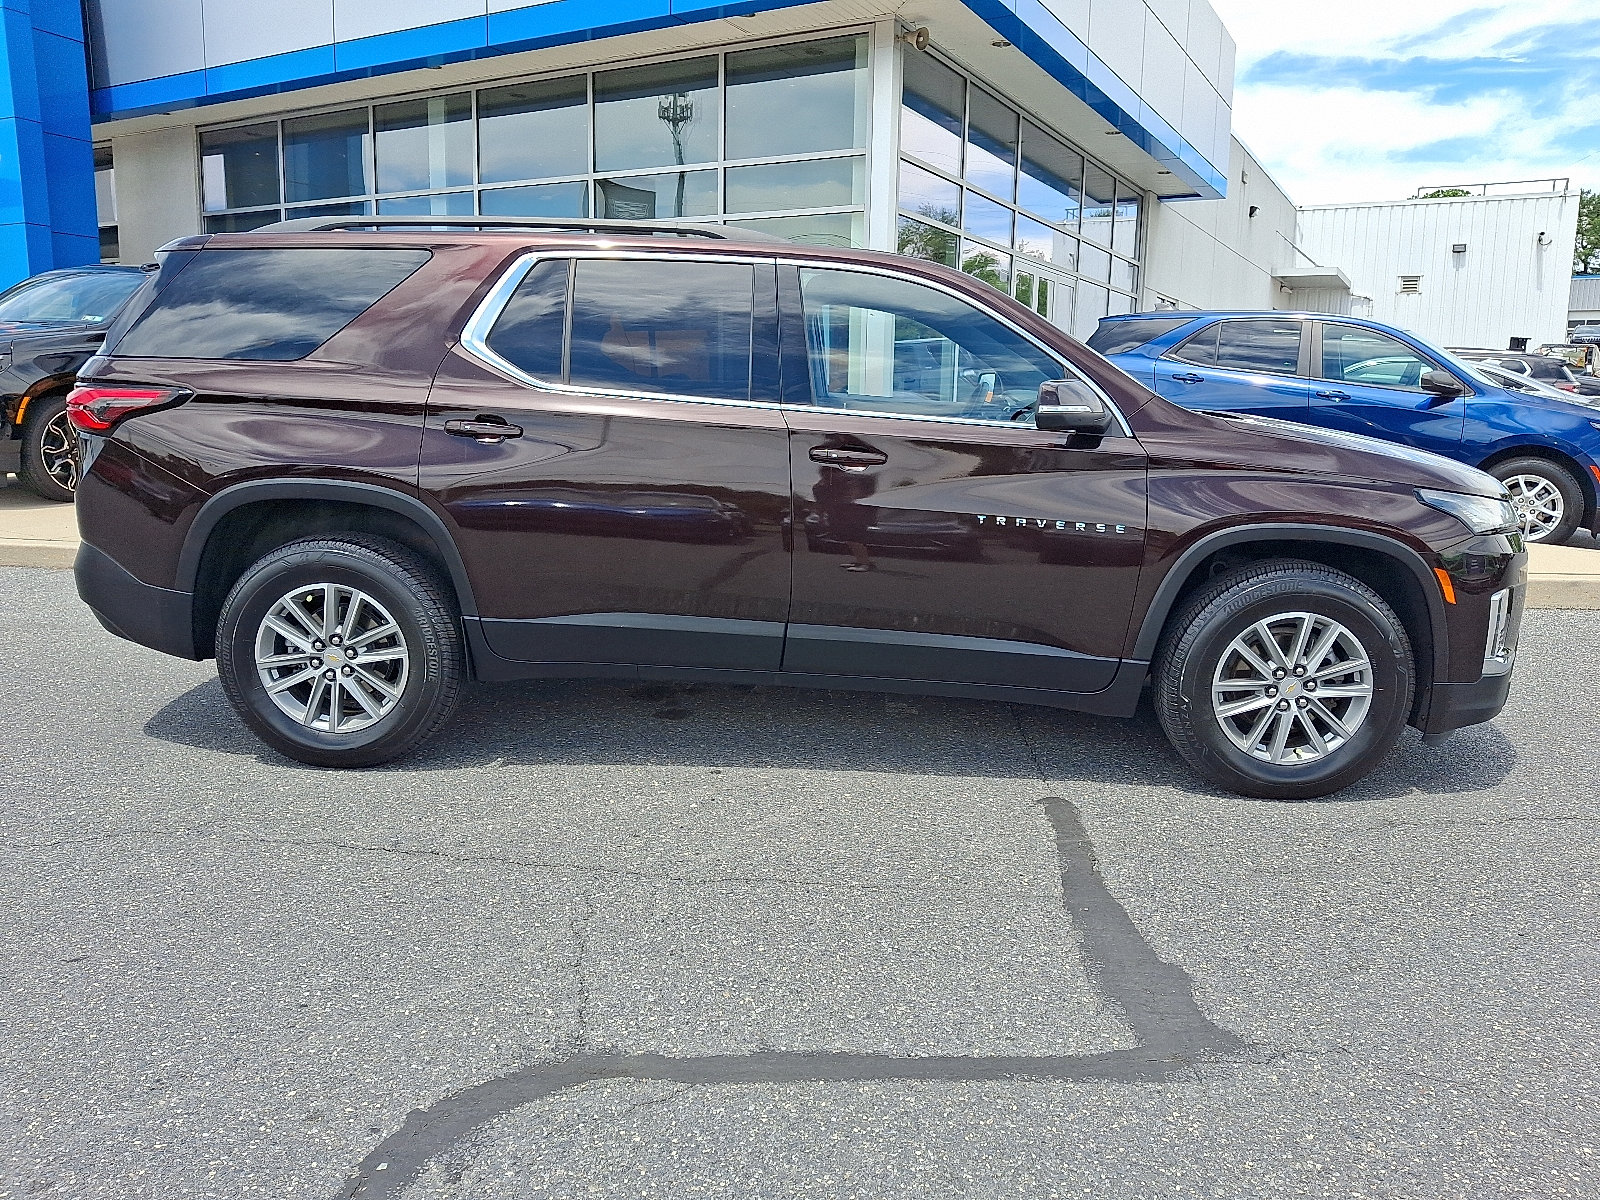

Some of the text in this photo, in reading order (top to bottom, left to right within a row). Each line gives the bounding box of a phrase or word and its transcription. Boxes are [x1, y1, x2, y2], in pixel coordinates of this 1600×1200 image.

[977, 514, 1126, 534] TRAVERSE
[1223, 580, 1304, 615] BRIDGESTONE
[413, 606, 440, 684] BRIDGESTONE
